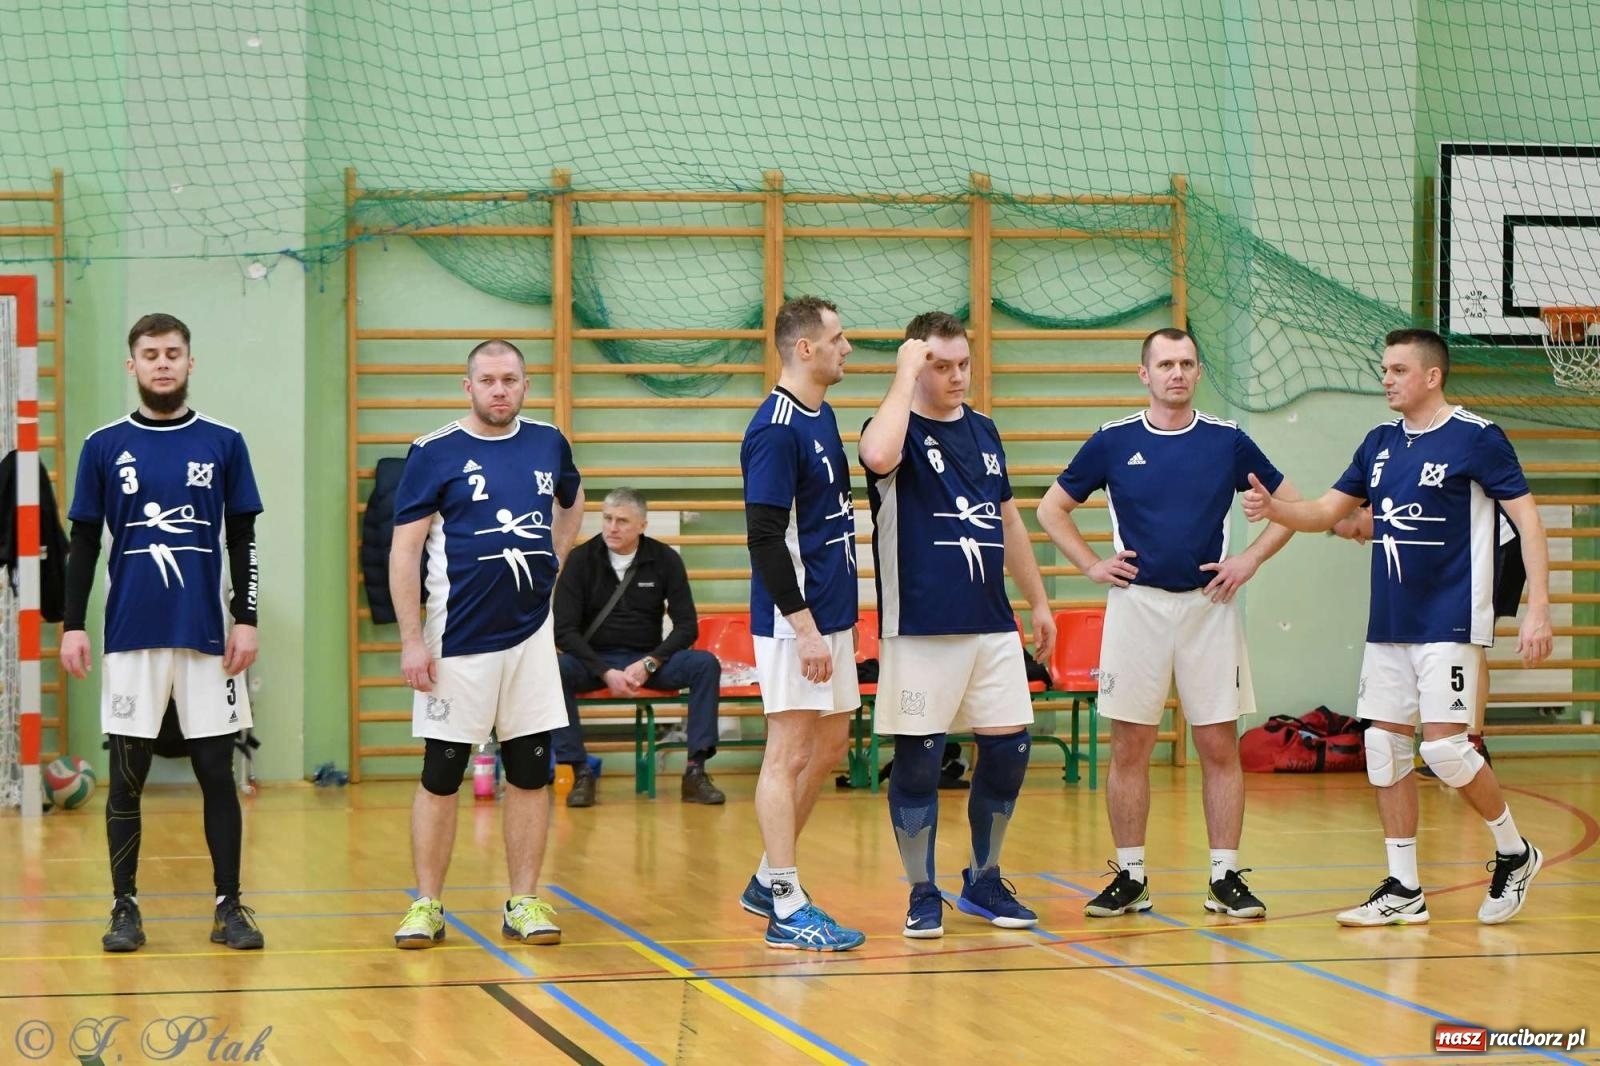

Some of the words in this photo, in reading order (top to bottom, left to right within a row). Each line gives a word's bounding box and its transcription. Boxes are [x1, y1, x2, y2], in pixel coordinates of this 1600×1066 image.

[822, 456, 834, 484] 1
[927, 448, 945, 473] 8
[119, 466, 139, 495] 3
[468, 474, 489, 502] 2
[1370, 462, 1385, 488] 5
[247, 581, 258, 605] CAN
[226, 678, 237, 706] 3
[1450, 665, 1465, 693] 5
